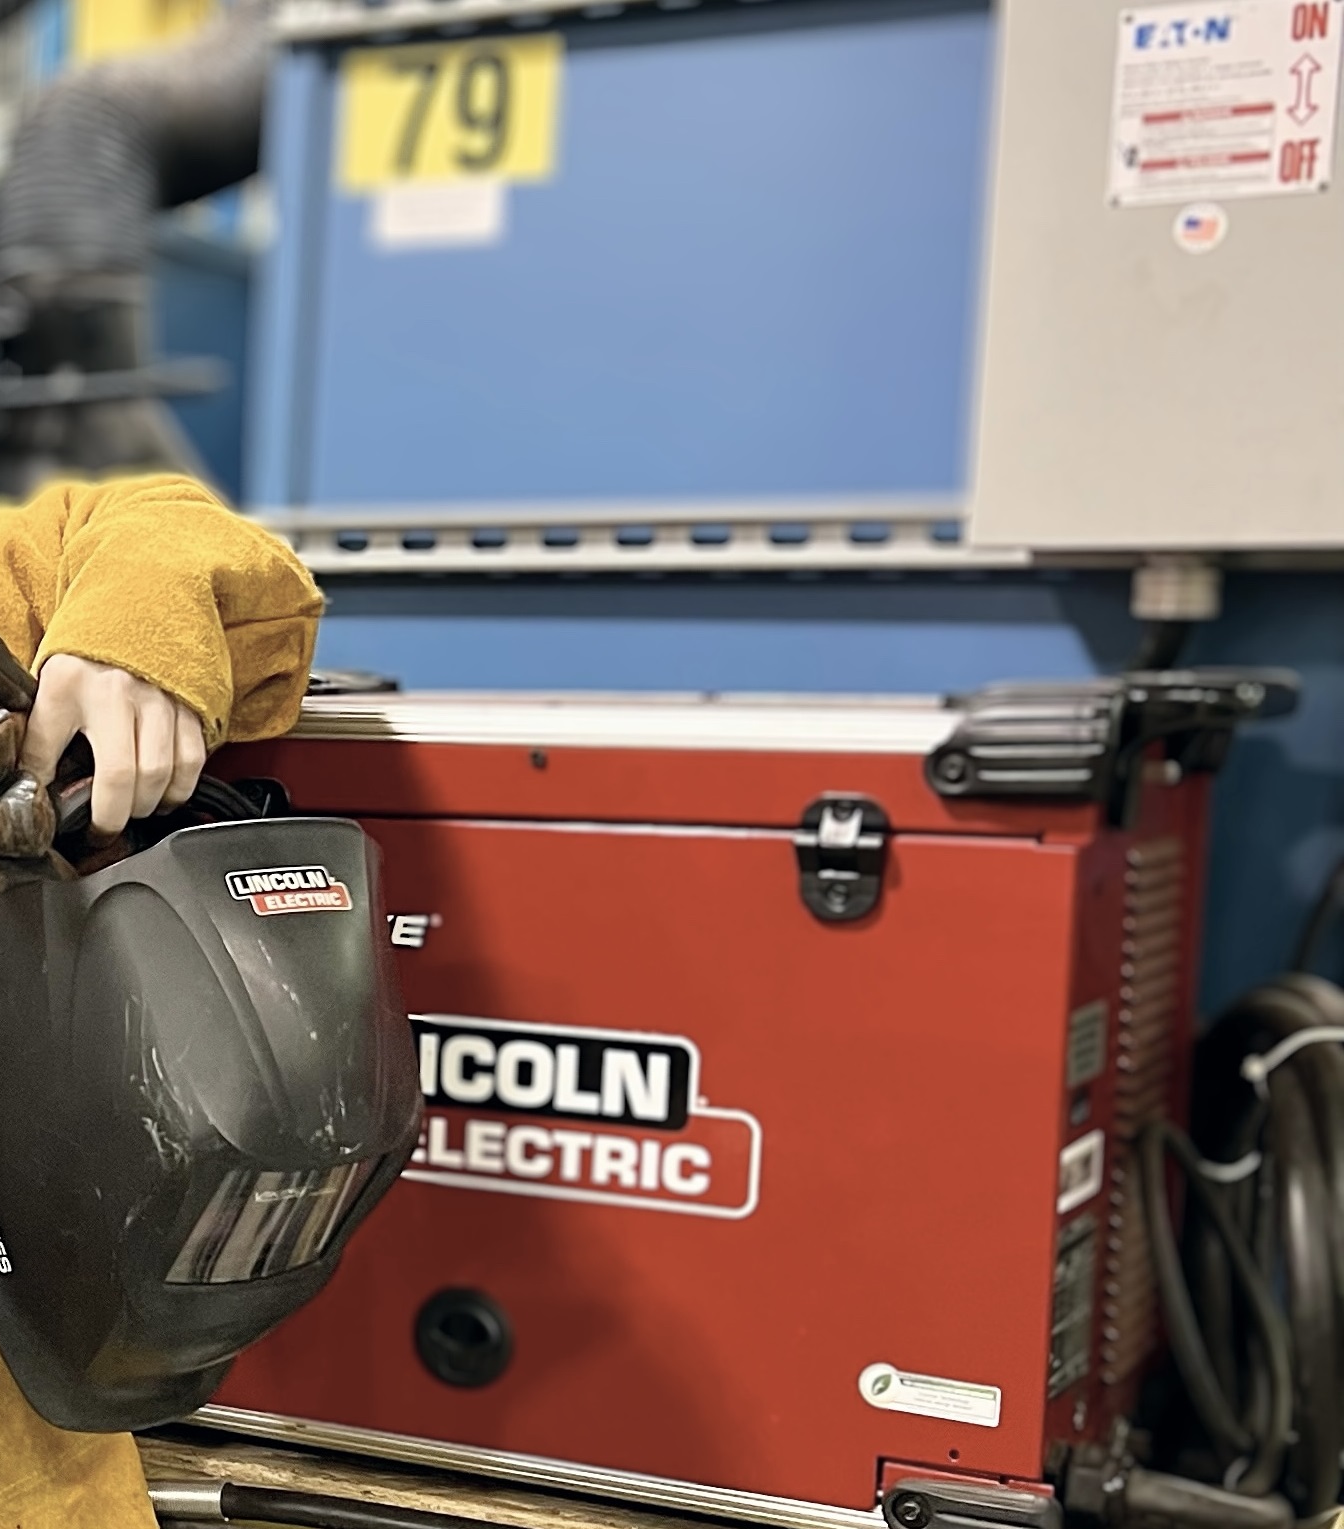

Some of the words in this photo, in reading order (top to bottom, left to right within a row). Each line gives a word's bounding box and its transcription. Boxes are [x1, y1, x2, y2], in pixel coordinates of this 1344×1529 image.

[1135, 17, 1231, 50] ETN
[1291, 2, 1329, 41] ON
[387, 45, 511, 180] 79
[1278, 138, 1321, 184] OFF
[233, 870, 328, 895] LINCOLN
[264, 892, 342, 910] ELECTRIC
[419, 1031, 672, 1123] COLN
